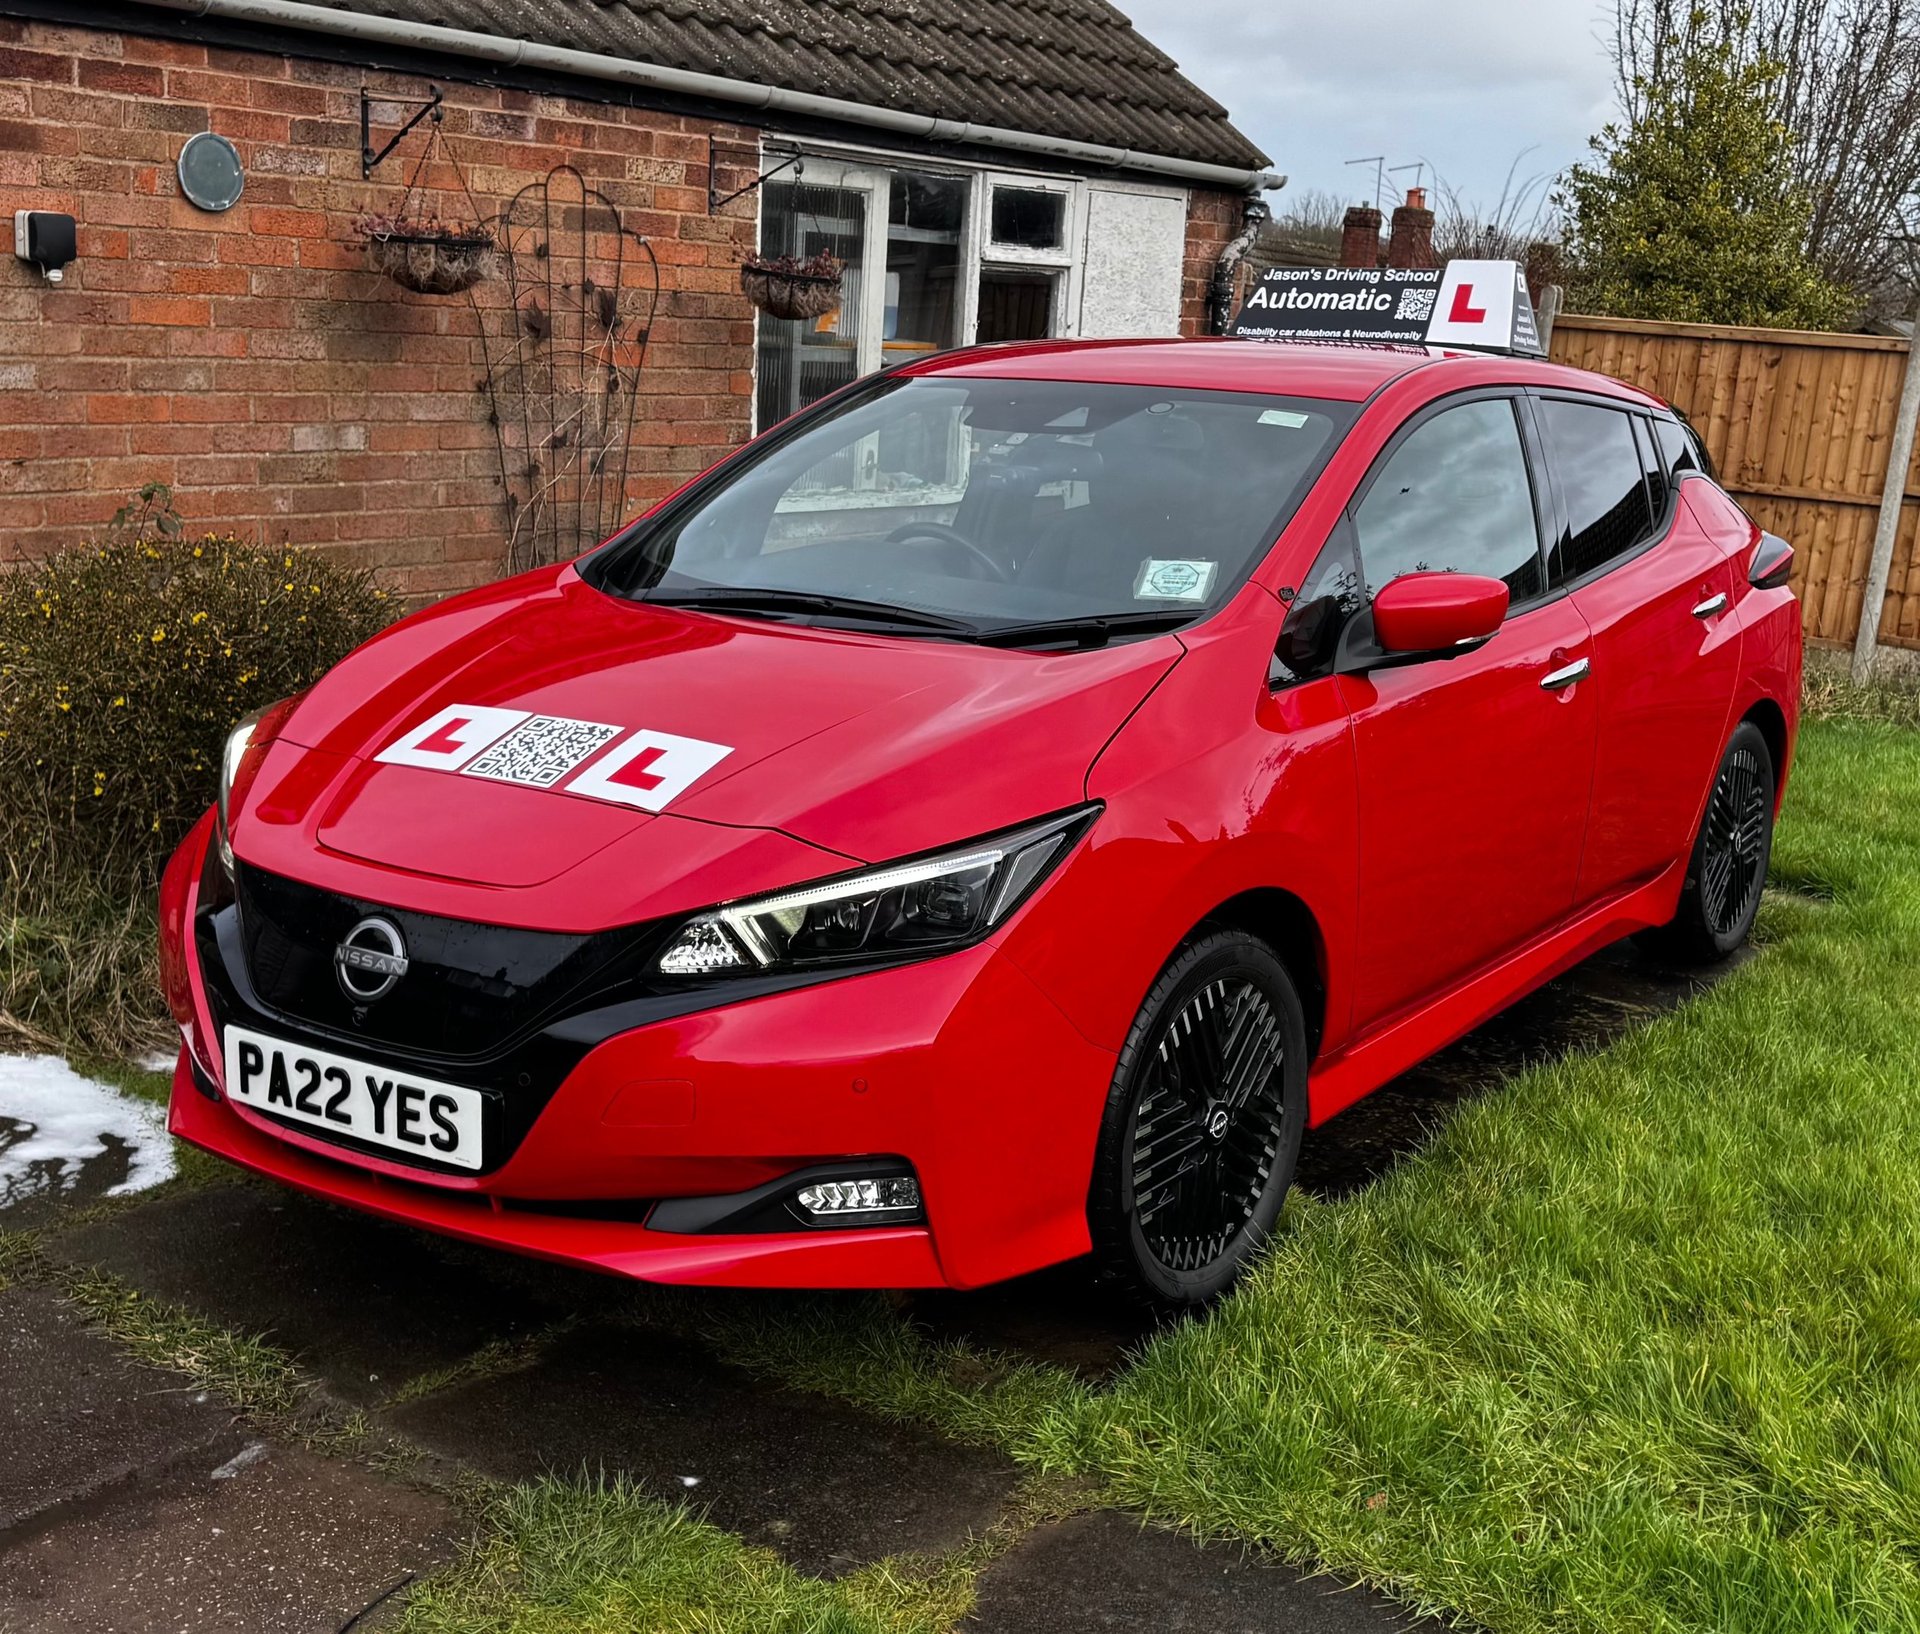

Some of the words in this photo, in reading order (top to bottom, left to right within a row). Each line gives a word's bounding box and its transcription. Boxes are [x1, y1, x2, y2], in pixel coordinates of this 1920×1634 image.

[1263, 268, 1322, 281] Jason's
[1325, 268, 1381, 284] Driving
[1384, 269, 1440, 283] School
[1247, 286, 1392, 311] Automatic
[1448, 284, 1487, 323] L
[1236, 326, 1278, 337] Disability
[1279, 329, 1295, 337] car
[1343, 330, 1350, 338] &
[1352, 329, 1422, 341] Neurodiversity
[411, 717, 473, 754] L
[605, 746, 669, 791] L
[336, 947, 406, 976] NISSAN
[238, 1040, 352, 1125] PA22
[365, 1075, 459, 1153] YES
